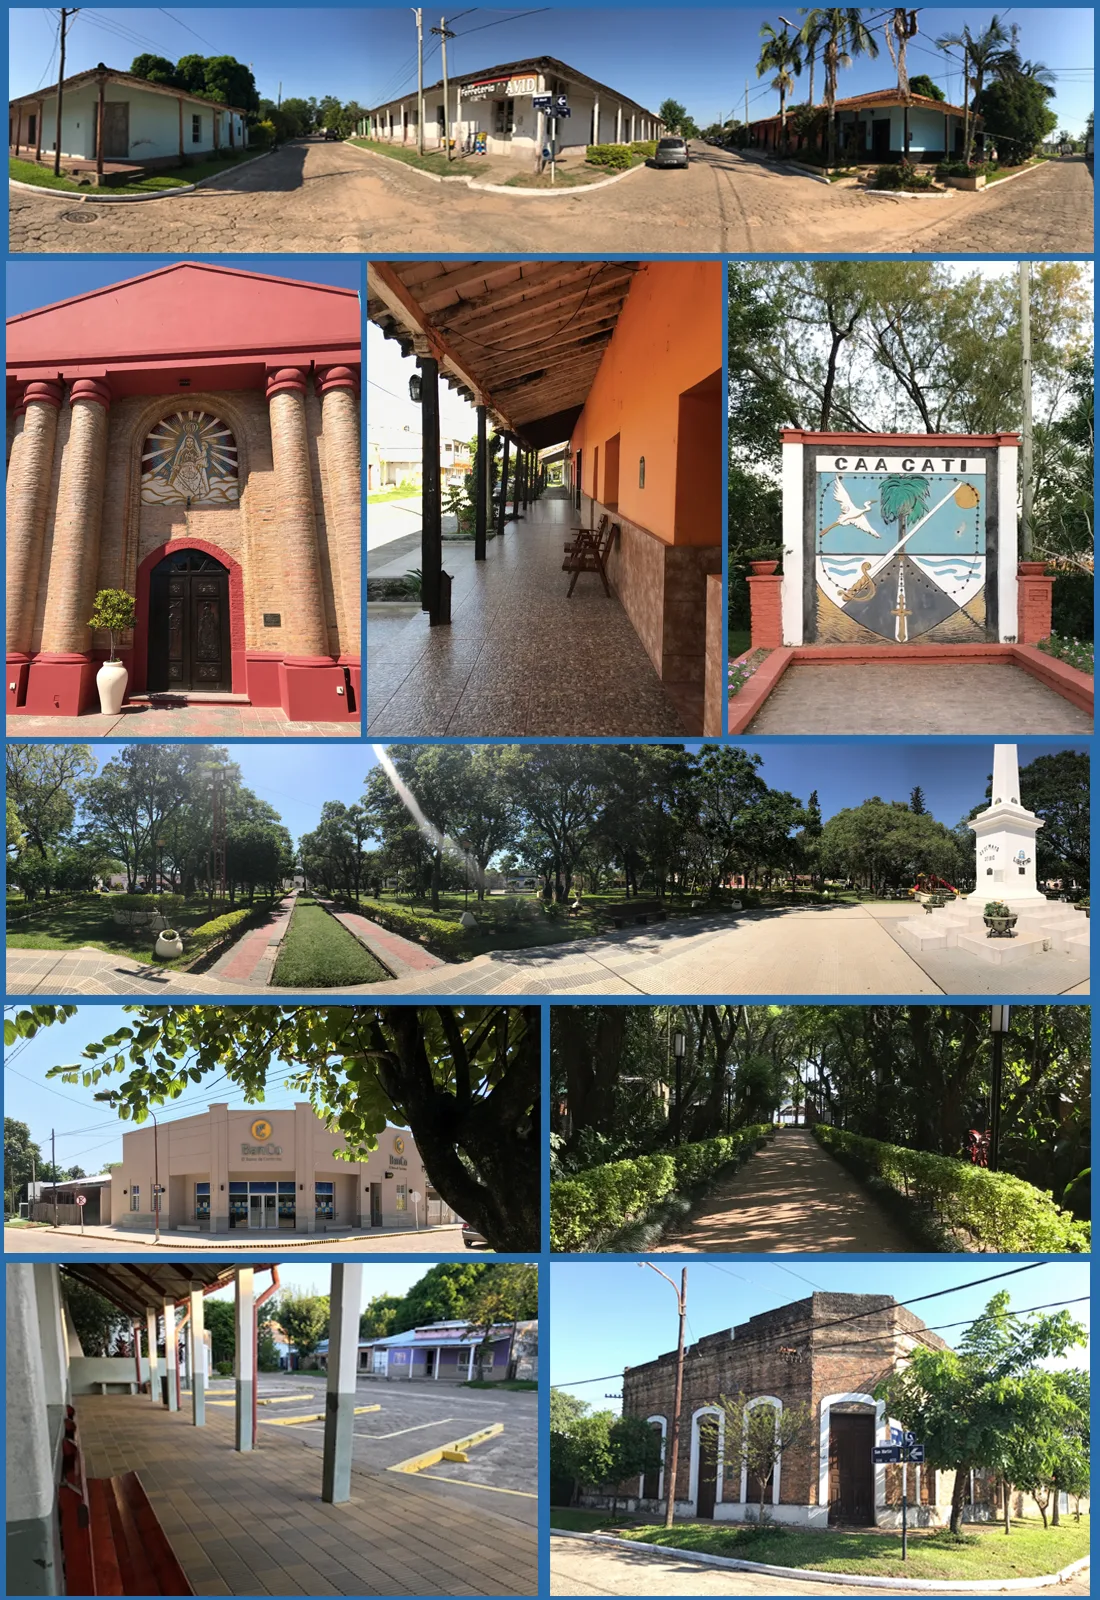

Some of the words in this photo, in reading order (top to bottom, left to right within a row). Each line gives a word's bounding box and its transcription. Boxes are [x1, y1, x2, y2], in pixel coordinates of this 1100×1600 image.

[834, 457, 888, 471] CAA
[901, 458, 967, 472] CATI
[241, 1143, 283, 1156] BanCo
